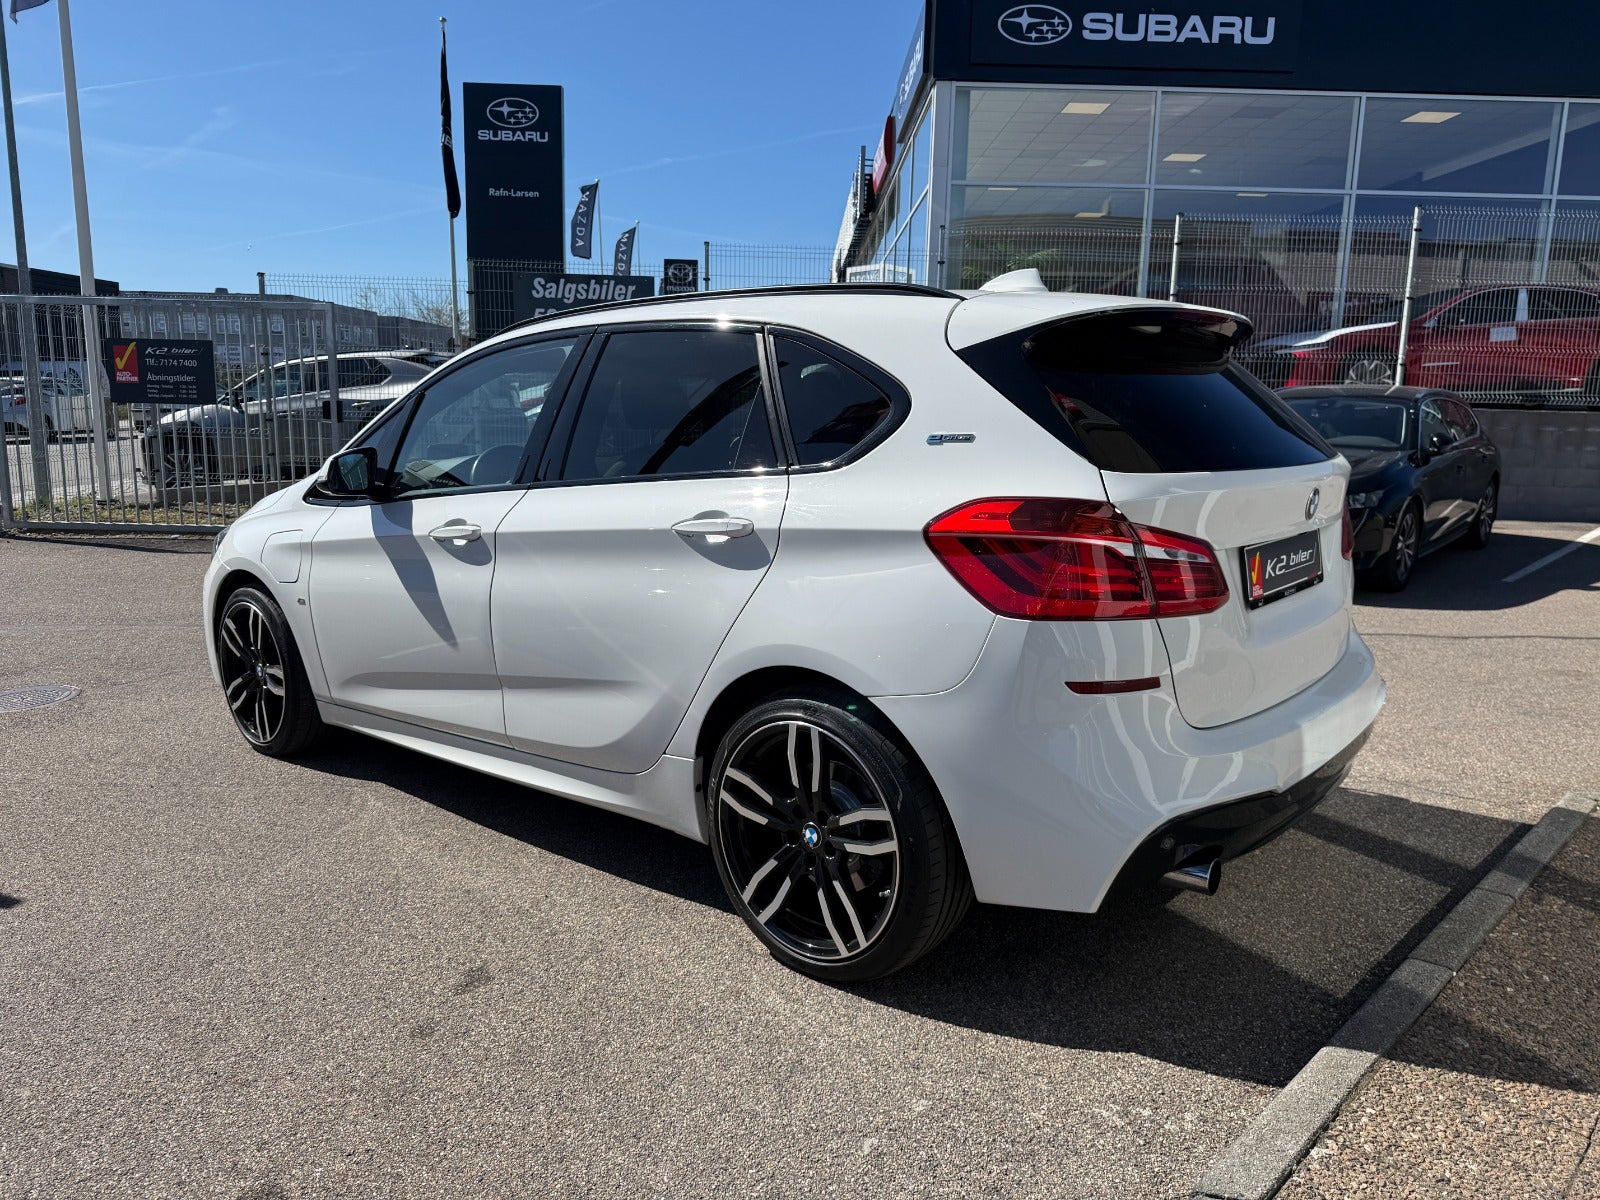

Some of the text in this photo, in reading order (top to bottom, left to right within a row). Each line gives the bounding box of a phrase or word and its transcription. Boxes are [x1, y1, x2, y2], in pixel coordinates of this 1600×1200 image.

[1081, 12, 1276, 45] SUBARU
[477, 129, 549, 142] SUBARU
[488, 188, 540, 198] Rafn-Larsen
[575, 191, 590, 247] MAZDA
[616, 232, 629, 275] MAZD
[531, 277, 636, 303] Salgsbiler
[145, 346, 168, 355] K2
[160, 359, 178, 367] 7174
[179, 359, 198, 367] 7400
[146, 371, 197, 383] Åbningstider:
[1265, 549, 1314, 579] K2 biler
